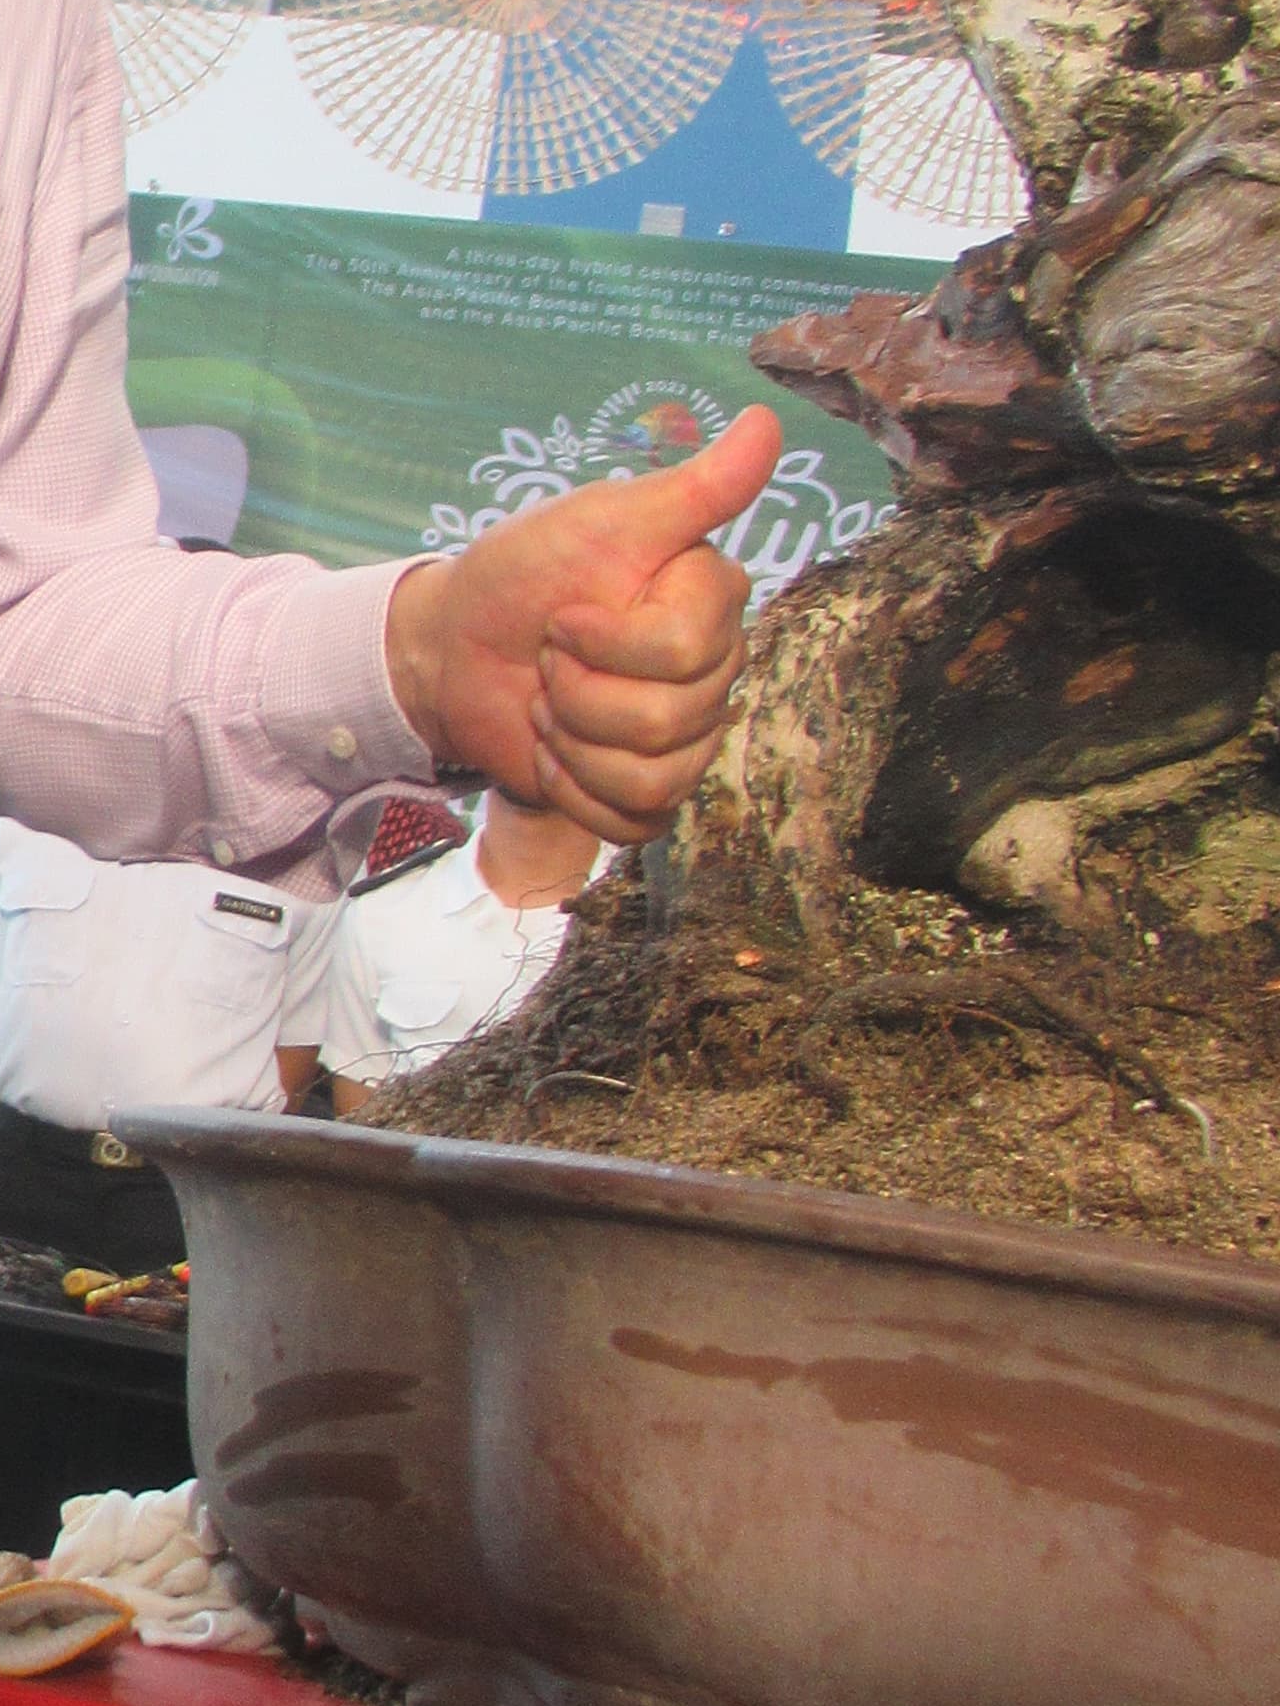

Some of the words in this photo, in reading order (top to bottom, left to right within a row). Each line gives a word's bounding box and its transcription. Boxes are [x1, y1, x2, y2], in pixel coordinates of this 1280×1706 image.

[304, 253, 340, 271] The
[348, 257, 390, 275] 50th
[397, 262, 514, 289] Anniversary
[520, 274, 541, 289] of
[549, 275, 580, 293] the
[587, 278, 674, 305] founding
[681, 289, 702, 304] of
[709, 291, 742, 307] the
[446, 245, 461, 263] A
[465, 249, 560, 274] three-day
[568, 258, 634, 277] hybrid
[639, 265, 754, 289] celebration
[361, 277, 396, 296] The
[401, 282, 523, 308] Asia-Pacific
[528, 292, 597, 315] Bonsai
[603, 302, 642, 319] and
[650, 303, 725, 325] Suiseki
[420, 305, 458, 322] and
[463, 307, 495, 327] the
[501, 311, 623, 338] Asia-Pacific
[628, 321, 698, 343] Bonsai
